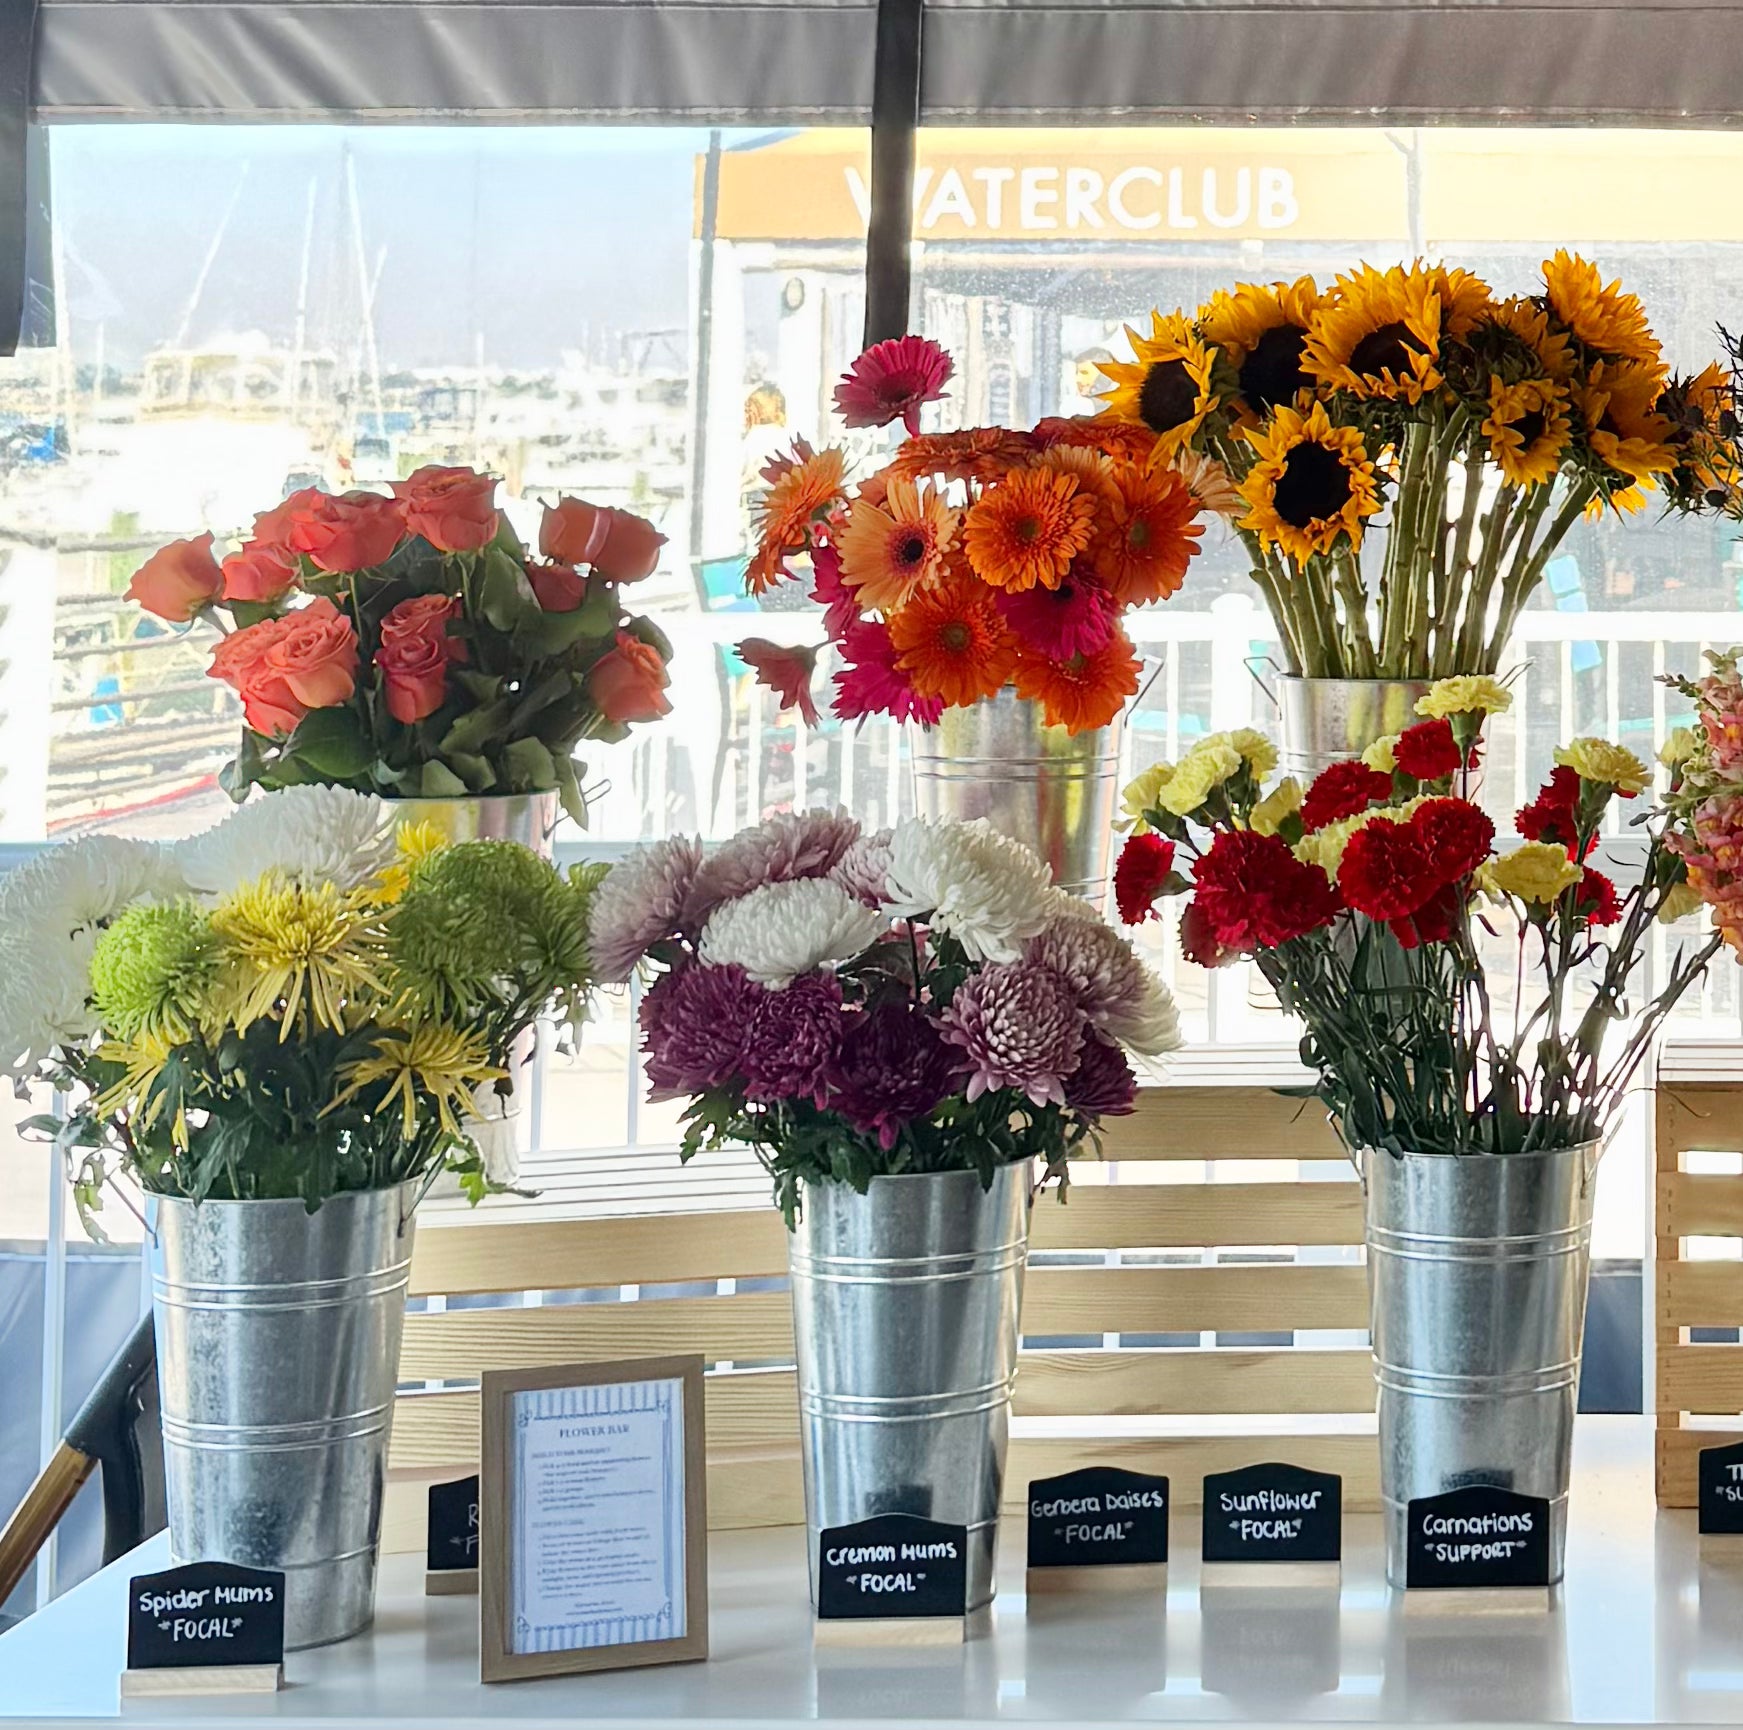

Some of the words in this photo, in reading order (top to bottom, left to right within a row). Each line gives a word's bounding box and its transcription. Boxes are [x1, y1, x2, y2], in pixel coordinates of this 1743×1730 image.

[559, 1425, 606, 1439] FLOWER
[1032, 1497, 1100, 1517] Gerbera
[1220, 1490, 1322, 1512] Sunflower
[1423, 1513, 1533, 1535] Carnations
[827, 1546, 895, 1566] Cremon
[139, 1588, 210, 1617] Spider
[215, 1586, 273, 1604] Mums
